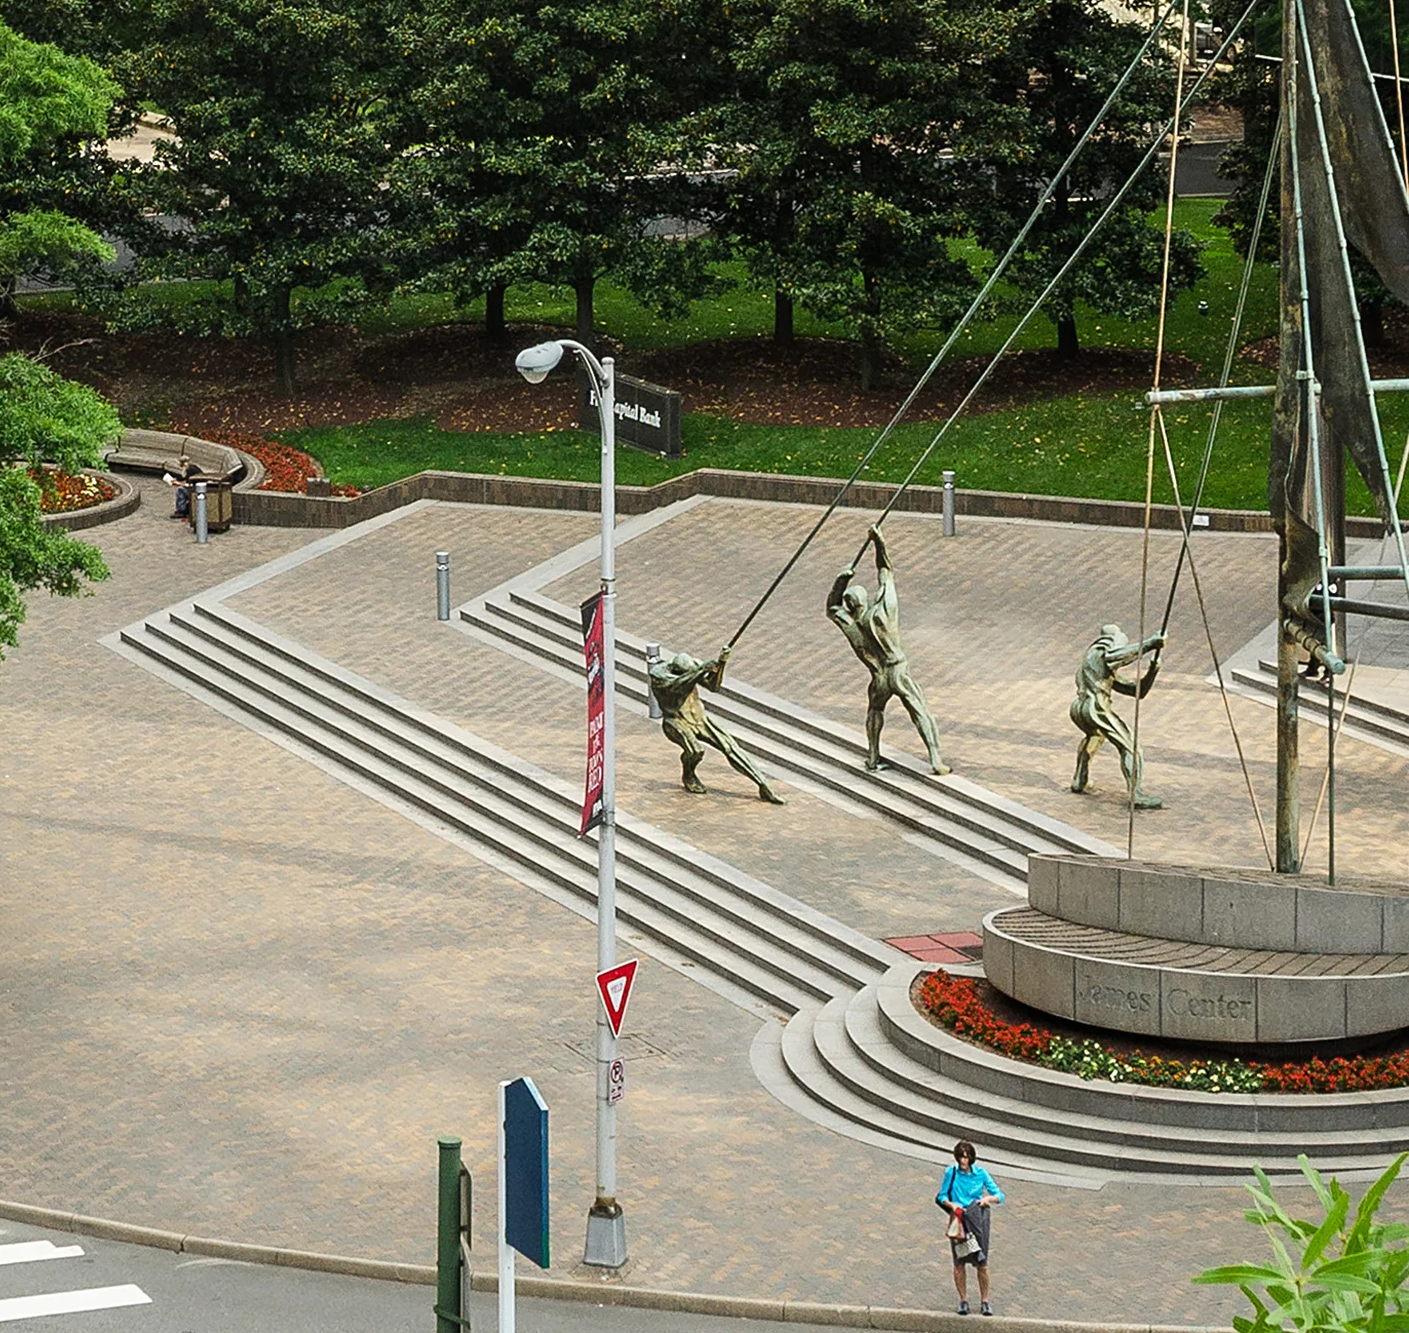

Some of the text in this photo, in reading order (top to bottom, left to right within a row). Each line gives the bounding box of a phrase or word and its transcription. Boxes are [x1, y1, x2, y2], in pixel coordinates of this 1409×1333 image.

[612, 397, 639, 421] apital
[639, 406, 661, 428] Bank
[1079, 974, 1252, 1021] James Center
